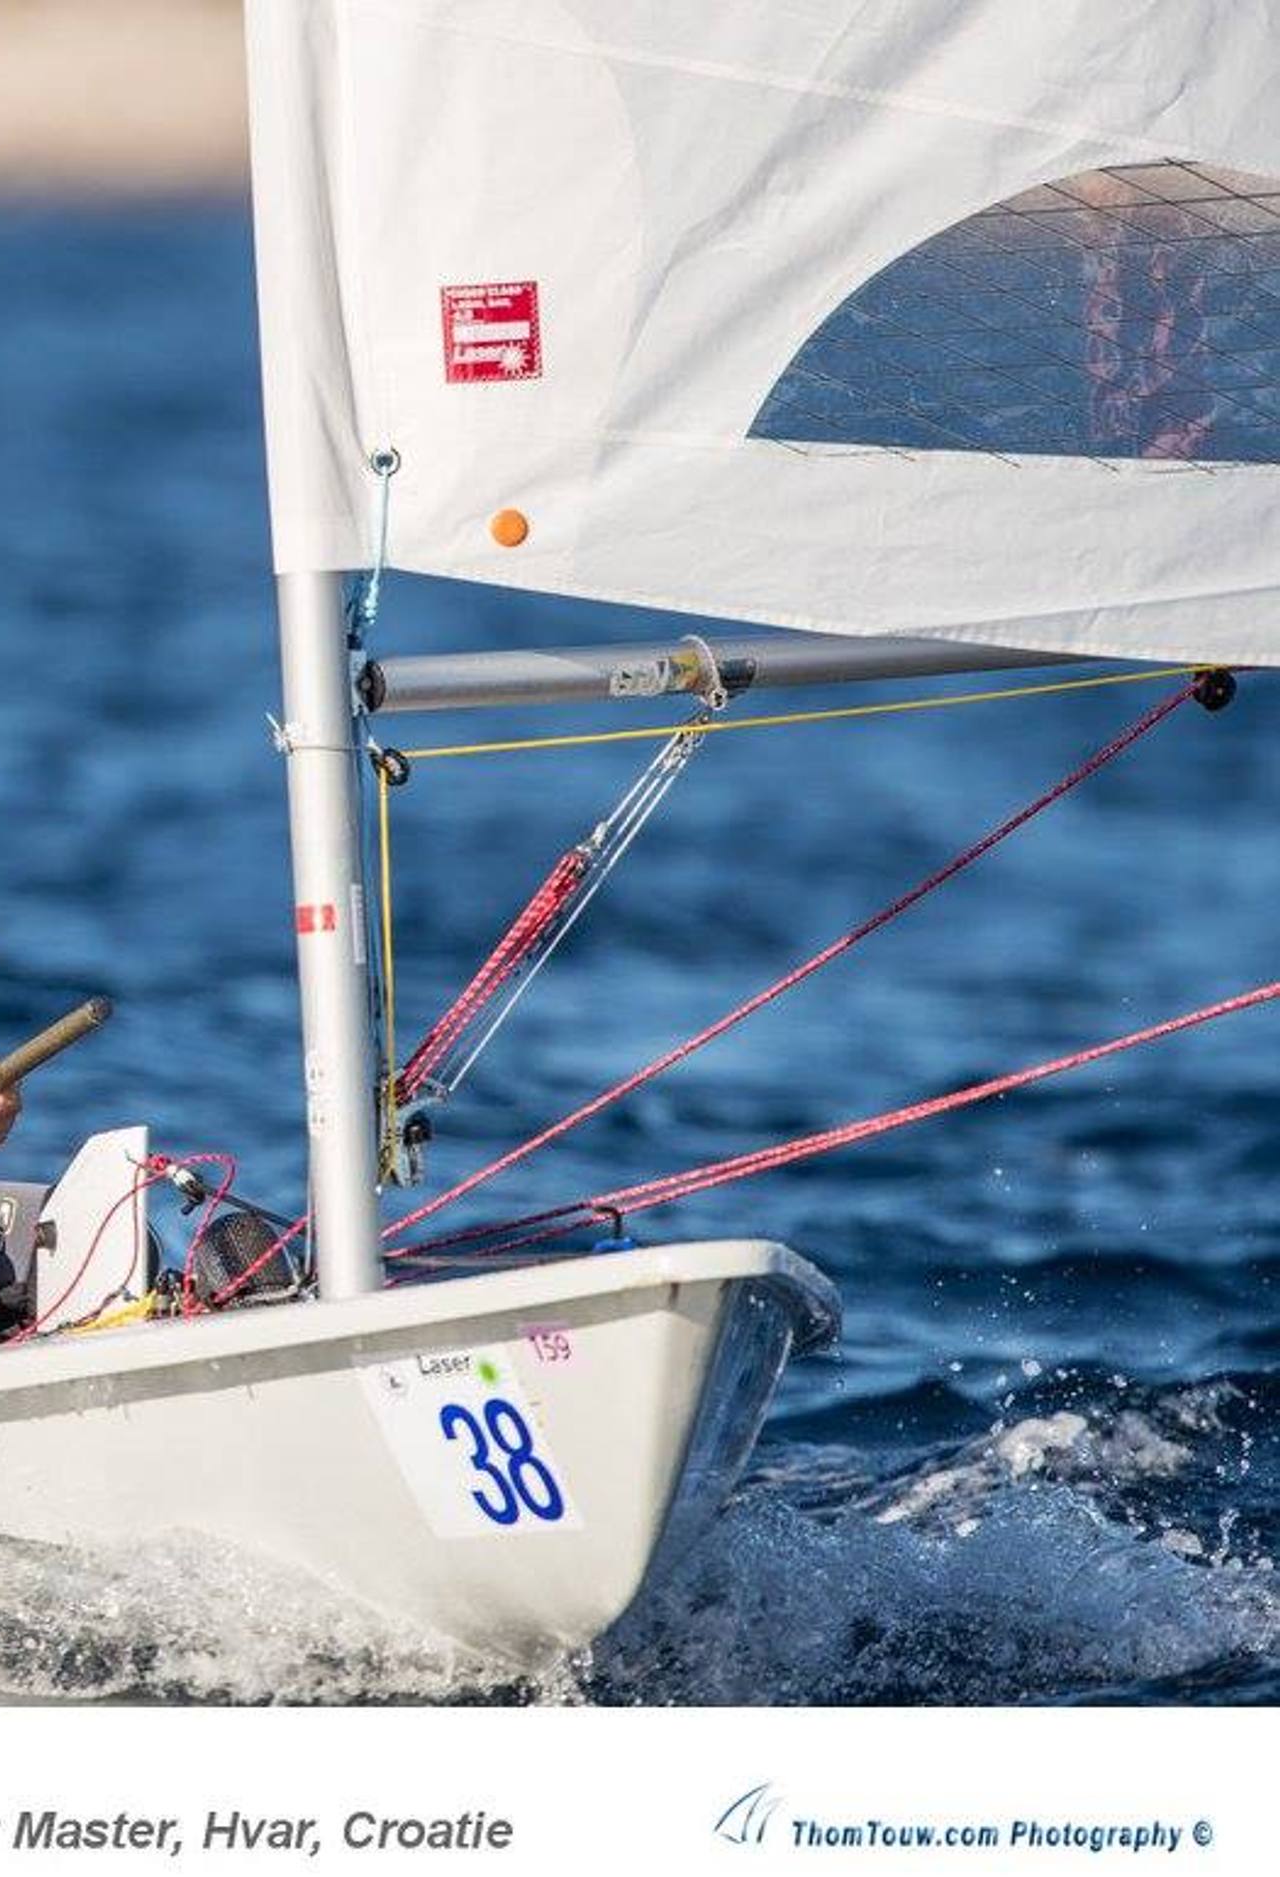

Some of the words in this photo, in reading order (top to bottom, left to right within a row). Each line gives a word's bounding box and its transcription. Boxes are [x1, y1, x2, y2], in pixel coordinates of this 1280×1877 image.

[528, 1334, 571, 1362] 159
[416, 1352, 471, 1375] Laser
[439, 1398, 565, 1526] 38
